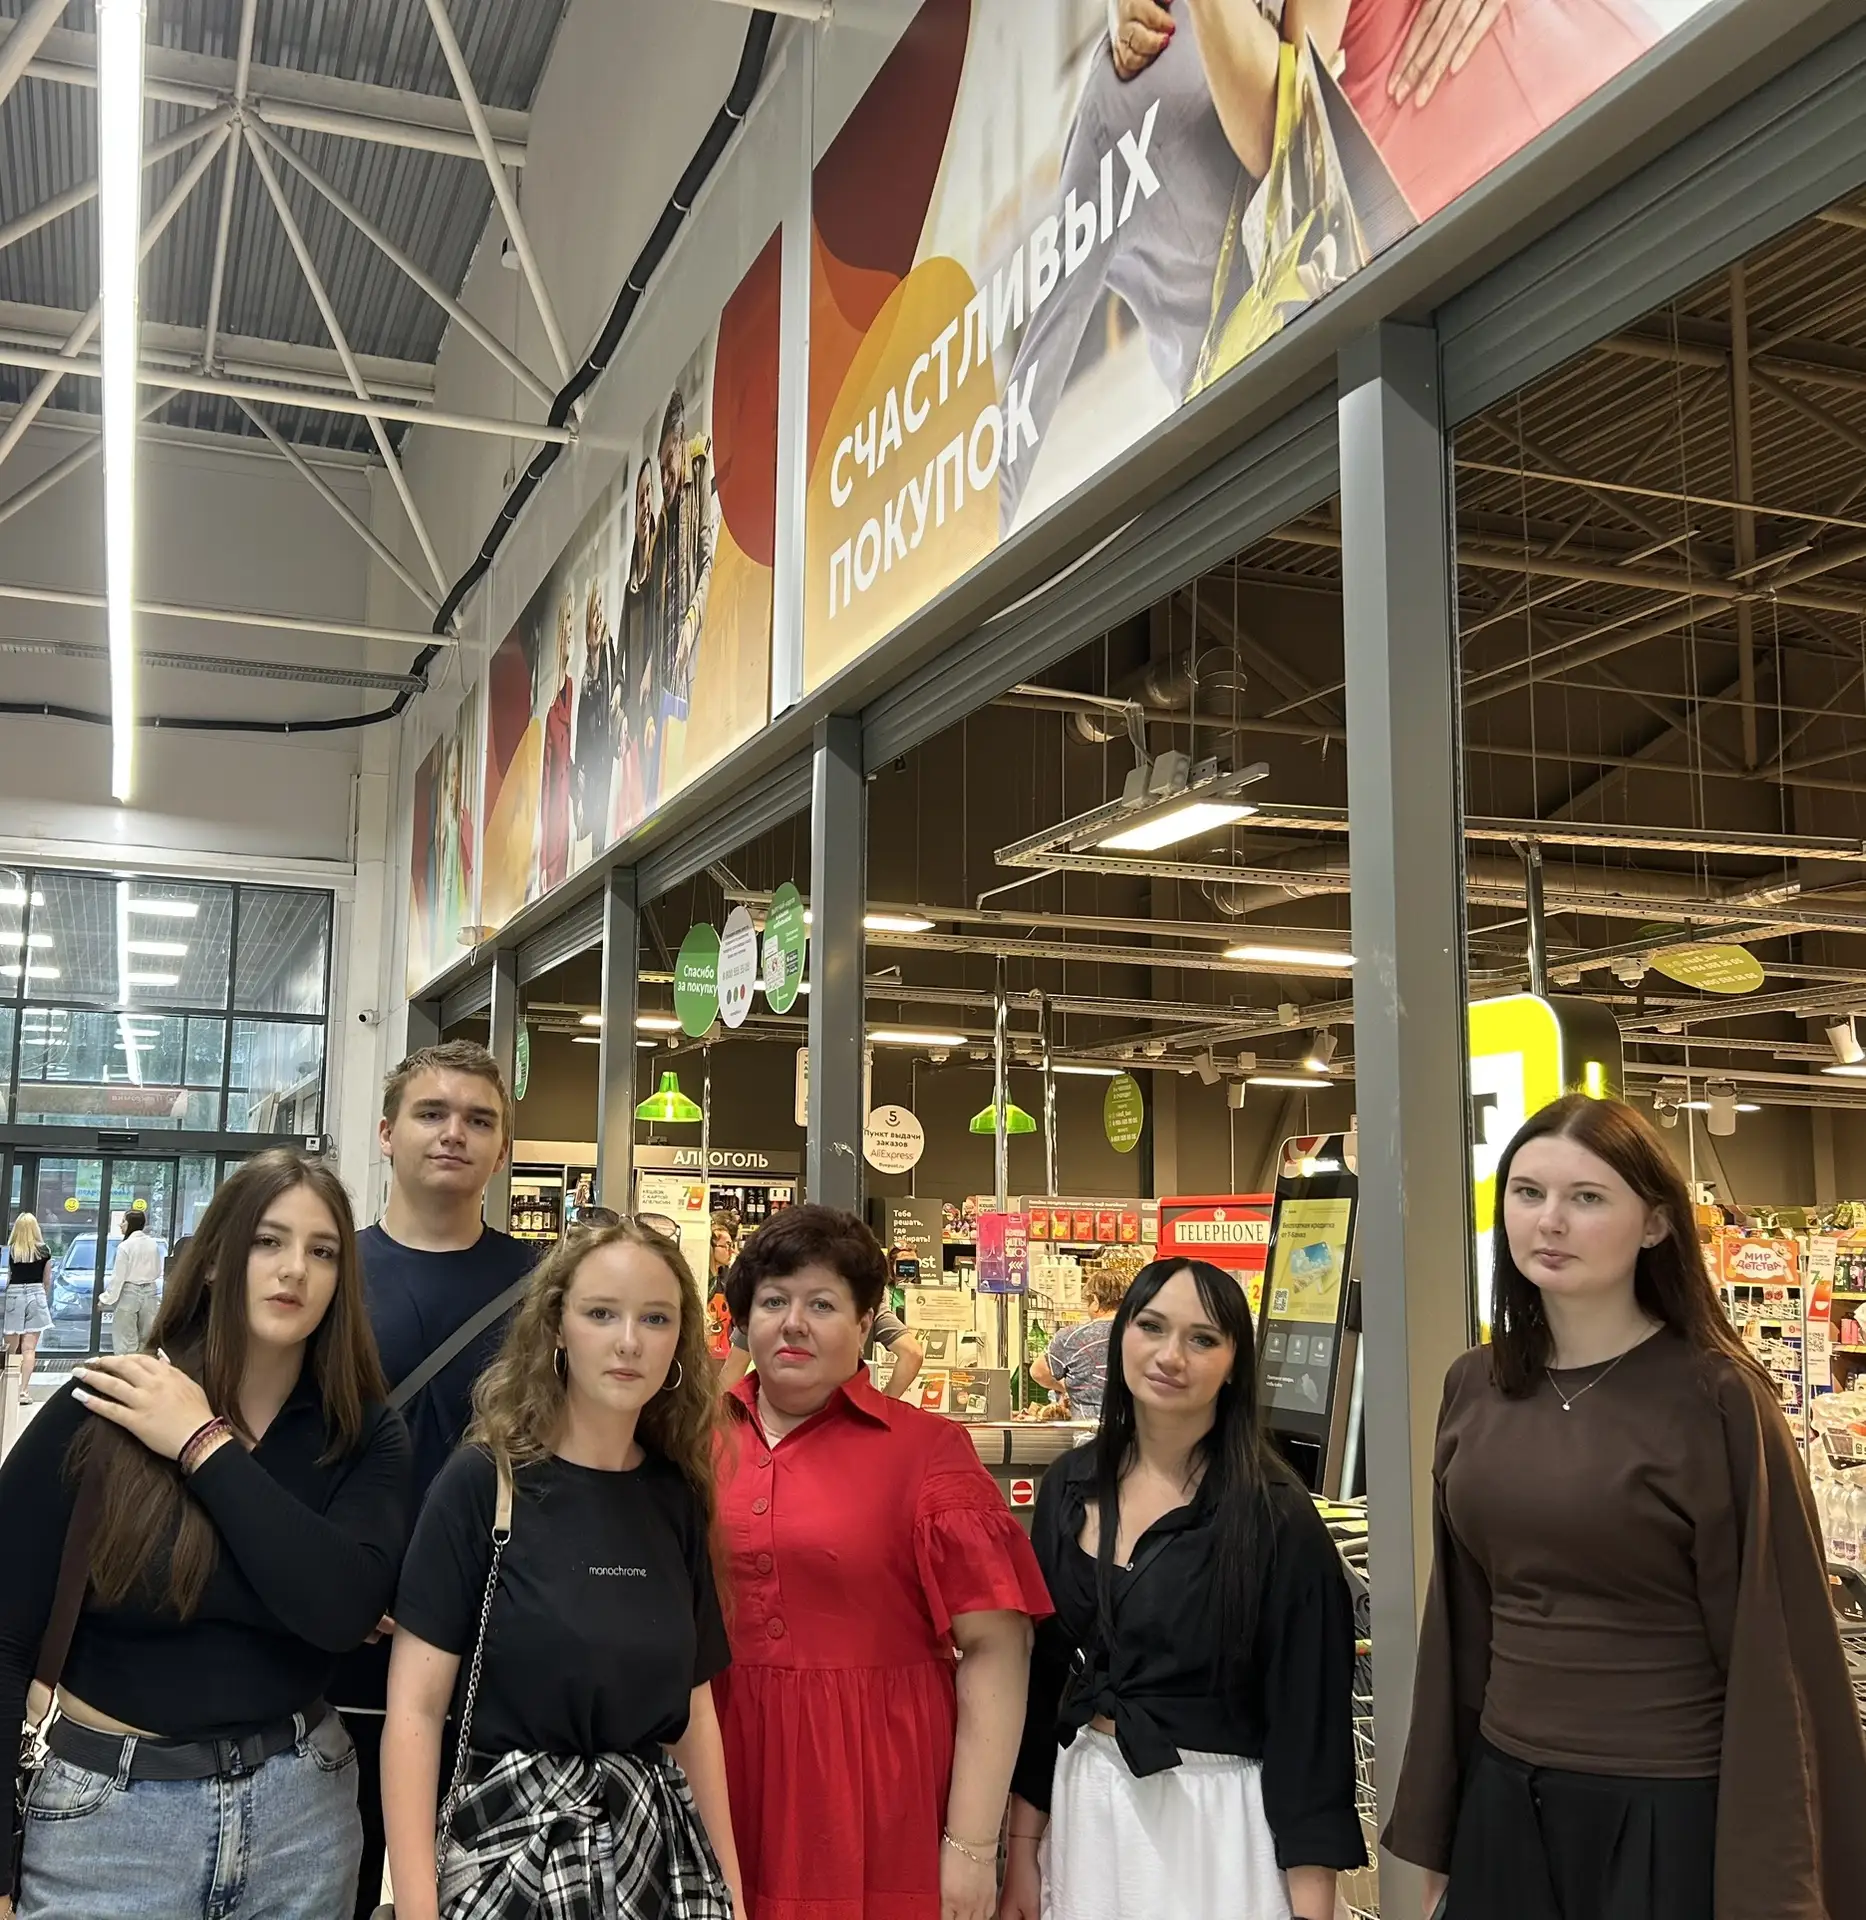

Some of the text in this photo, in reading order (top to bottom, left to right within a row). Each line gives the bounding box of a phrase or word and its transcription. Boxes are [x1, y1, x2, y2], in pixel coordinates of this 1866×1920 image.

[830, 98, 1160, 508] СЧАСТЛИВЫХ
[829, 360, 1040, 618] ПОКУПОК
[683, 964, 715, 979] Спасибо
[677, 981, 718, 997] за покупку
[889, 1111, 897, 1122] 5
[864, 1130, 921, 1140] Пункт выдачи
[876, 1140, 908, 1148] заказов
[870, 1149, 914, 1161] AliExpress
[893, 1209, 912, 1218] Тебе
[893, 1219, 924, 1227] решать,
[893, 1227, 907, 1235] где
[1179, 1224, 1264, 1242] TELEPHONE
[893, 1234, 931, 1243] забирать!
[1745, 1252, 1771, 1261] МИР
[589, 1565, 647, 1577] monochrome
